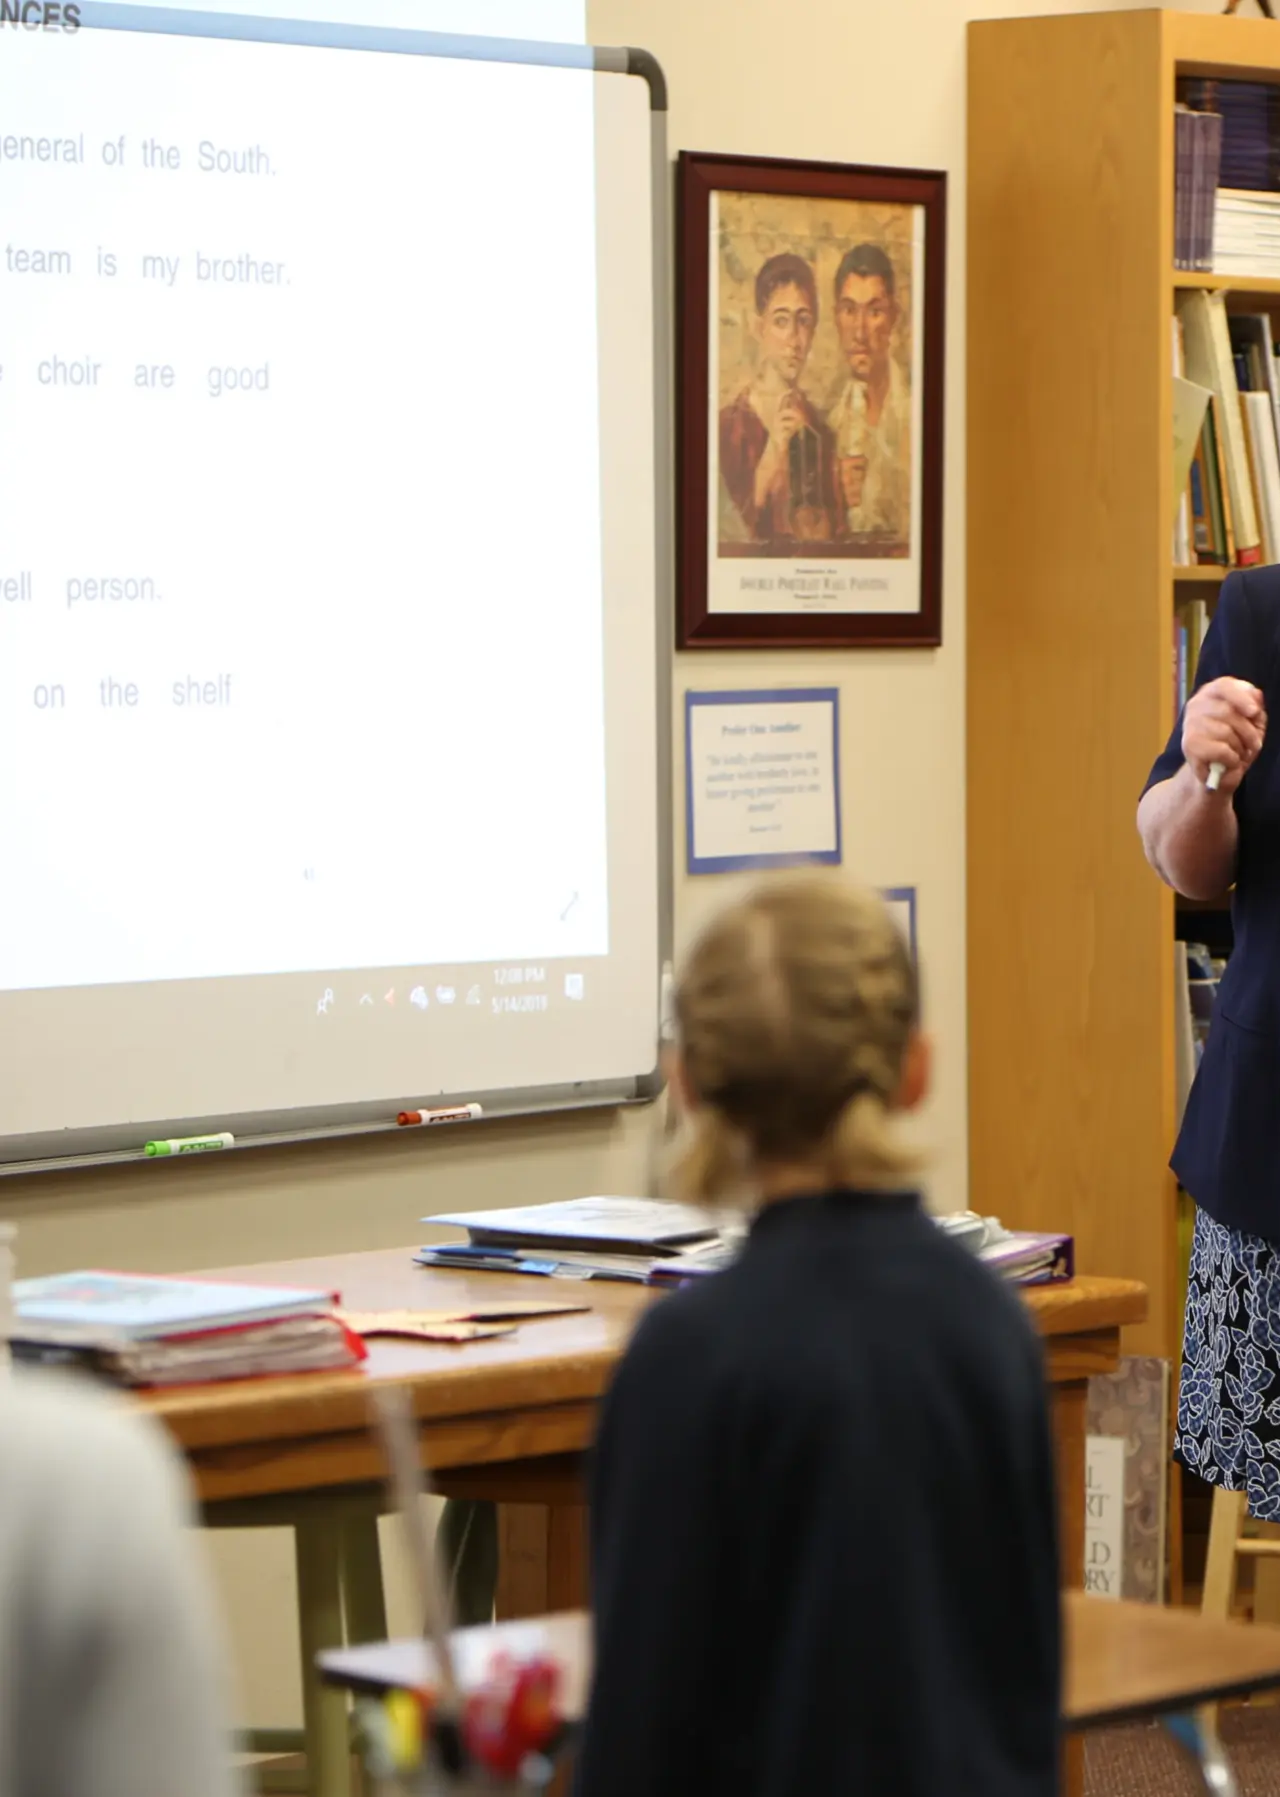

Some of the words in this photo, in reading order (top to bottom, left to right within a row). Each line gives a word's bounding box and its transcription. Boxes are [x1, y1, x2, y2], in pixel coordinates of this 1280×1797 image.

[0, 132, 84, 165] eneral
[102, 135, 126, 167] of
[141, 138, 181, 171] the
[197, 140, 277, 176] South.
[5, 243, 71, 275] team
[97, 246, 118, 277] is
[142, 254, 180, 288] my
[196, 251, 291, 285] brother.
[37, 354, 103, 386] choir
[133, 364, 176, 388] are
[207, 362, 270, 397] good
[0, 570, 32, 602] ell
[66, 576, 162, 610] person.
[33, 683, 66, 710] on
[99, 675, 140, 708] the
[172, 673, 232, 706] shelf
